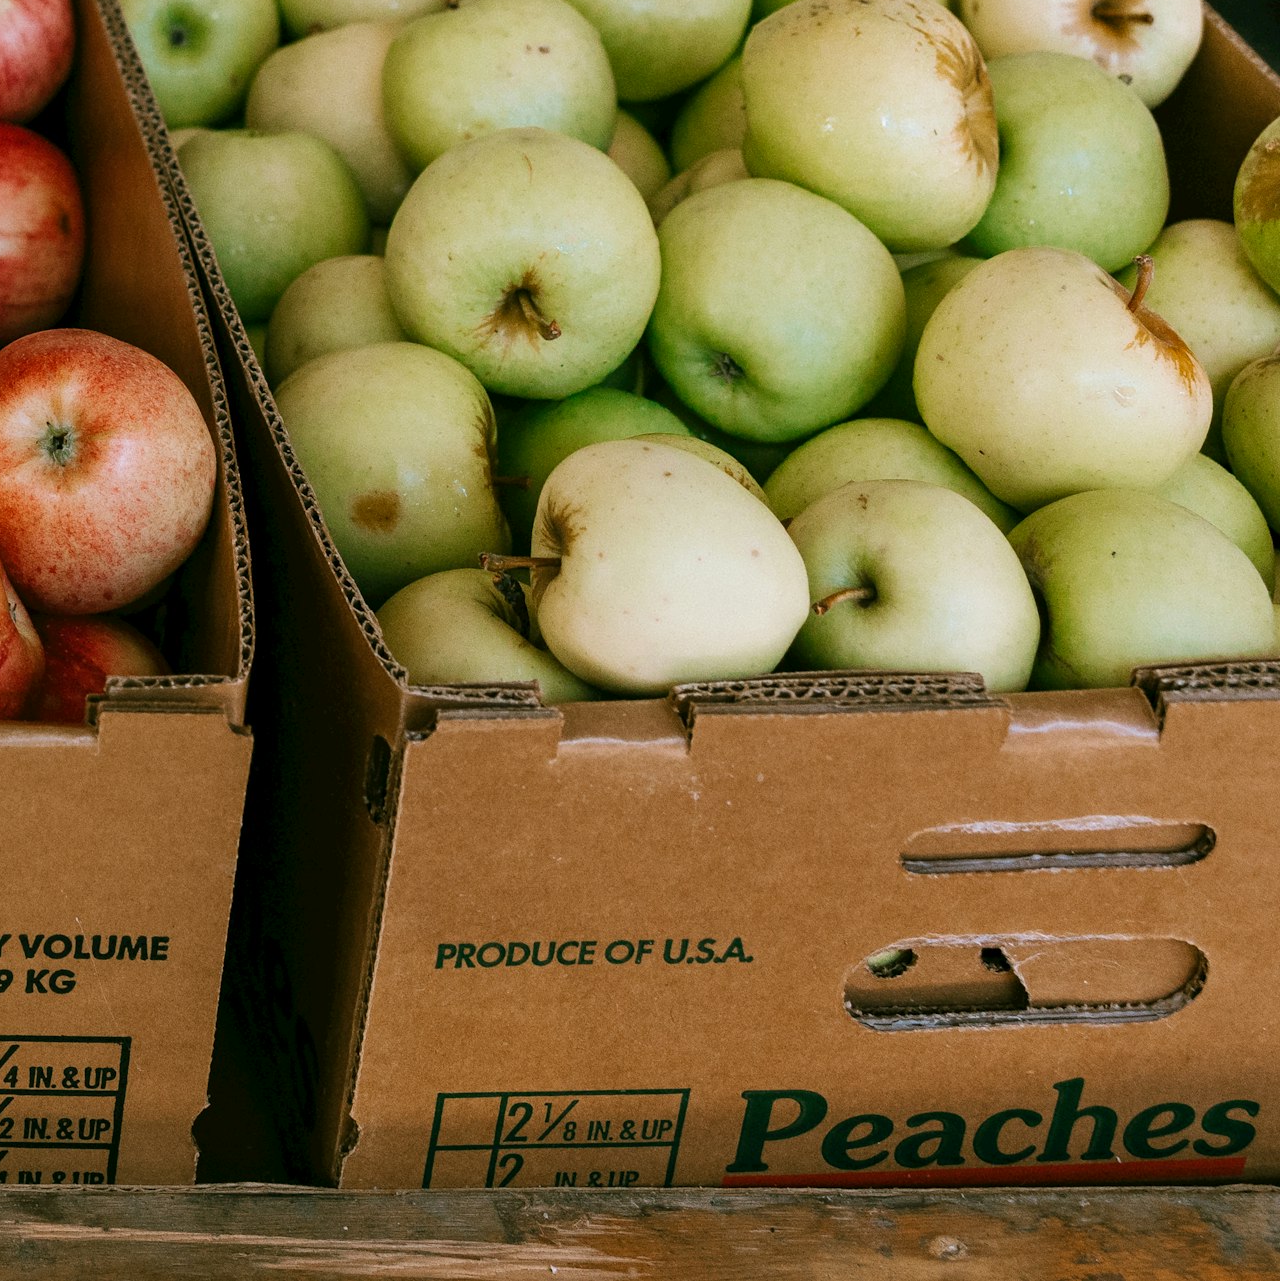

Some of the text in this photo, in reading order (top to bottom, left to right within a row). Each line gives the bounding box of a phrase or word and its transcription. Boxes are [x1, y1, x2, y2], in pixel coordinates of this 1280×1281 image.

[18, 933, 170, 961] VOLUME
[435, 937, 754, 969] PRODUCE OF U.S.A.
[25, 969, 77, 994] KG
[725, 1077, 1260, 1173] Peaches
